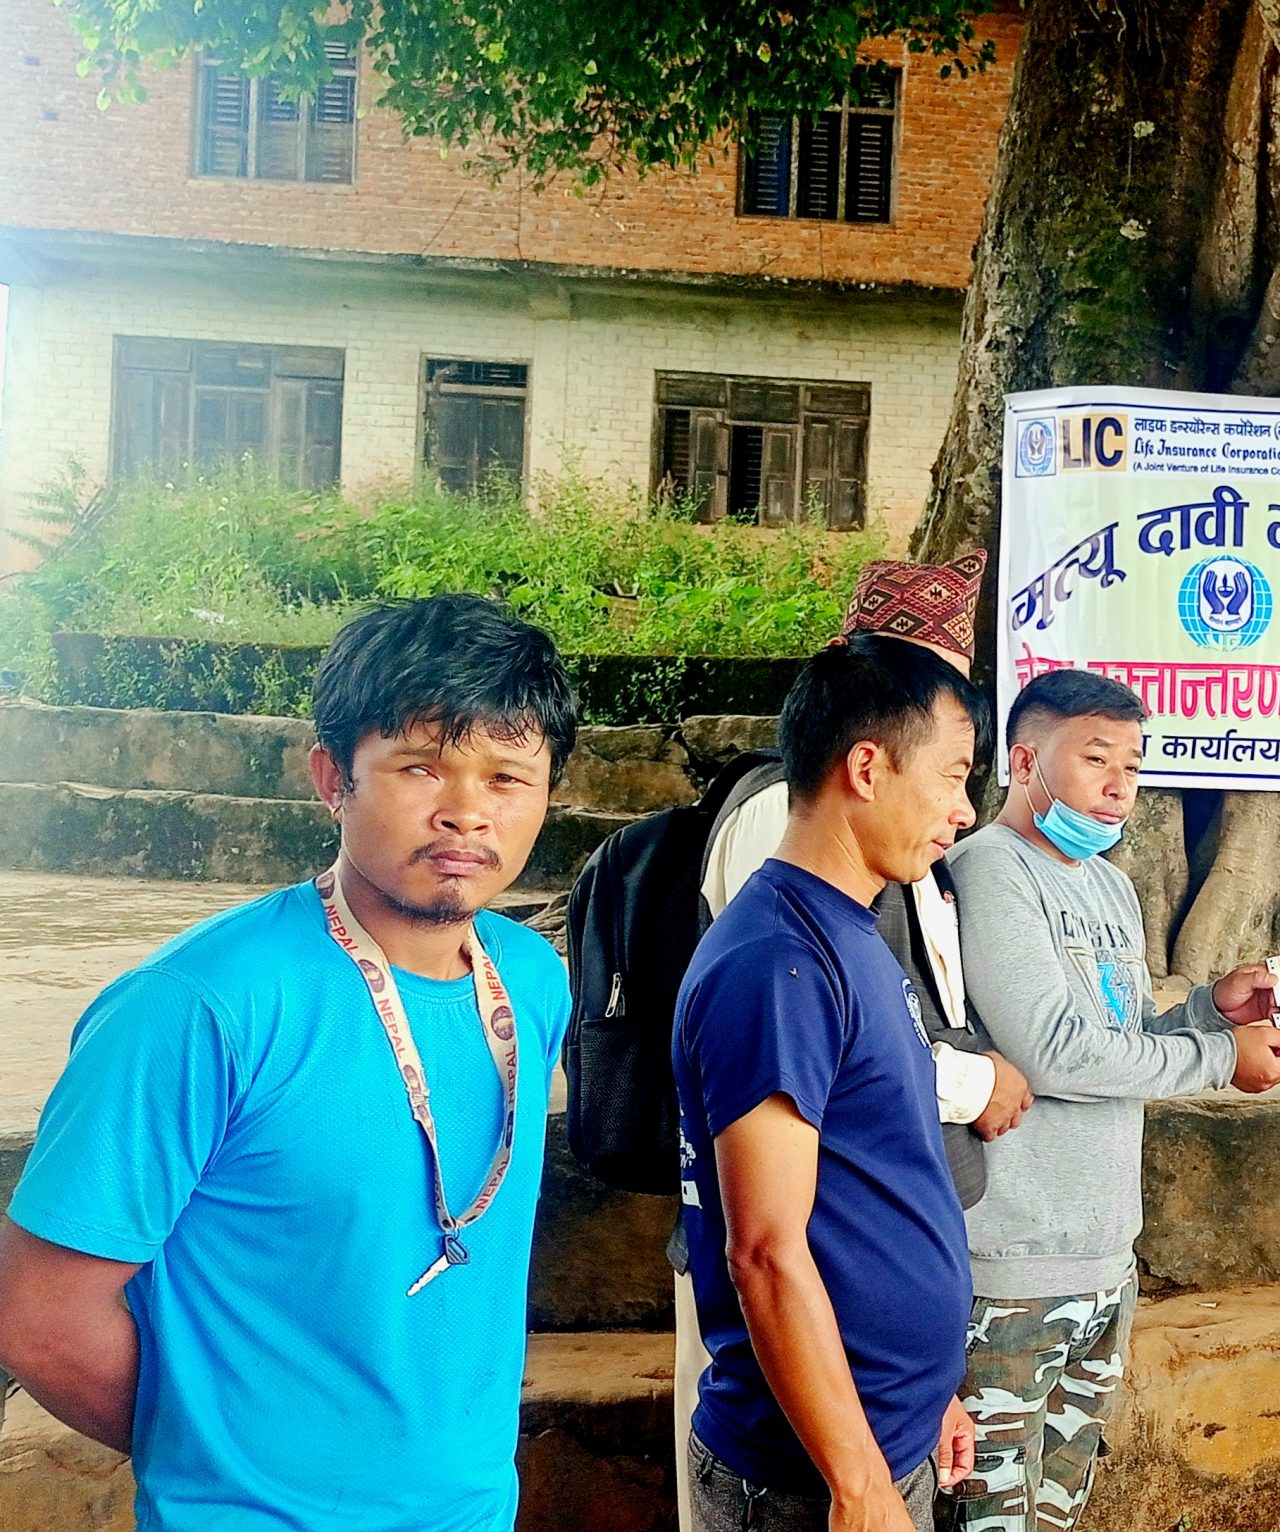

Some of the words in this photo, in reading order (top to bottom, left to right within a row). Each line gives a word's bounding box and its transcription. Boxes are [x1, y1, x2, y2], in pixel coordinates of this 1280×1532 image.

[1062, 417, 1123, 469] LIC
[1134, 418, 1167, 433] लाइफ
[1134, 437, 1154, 458] Life
[1157, 439, 1217, 457] Insurance
[1133, 461, 1142, 472] (A
[1144, 463, 1164, 472] Joint
[1166, 464, 1198, 473] Venture
[1201, 464, 1209, 473] of
[1211, 465, 1226, 473] Life
[1228, 465, 1268, 475] Insurance
[1137, 485, 1250, 557] दावी
[324, 904, 360, 955] NEPAL
[377, 999, 406, 1060] NEPAL
[505, 1044, 516, 1105] NEPAL
